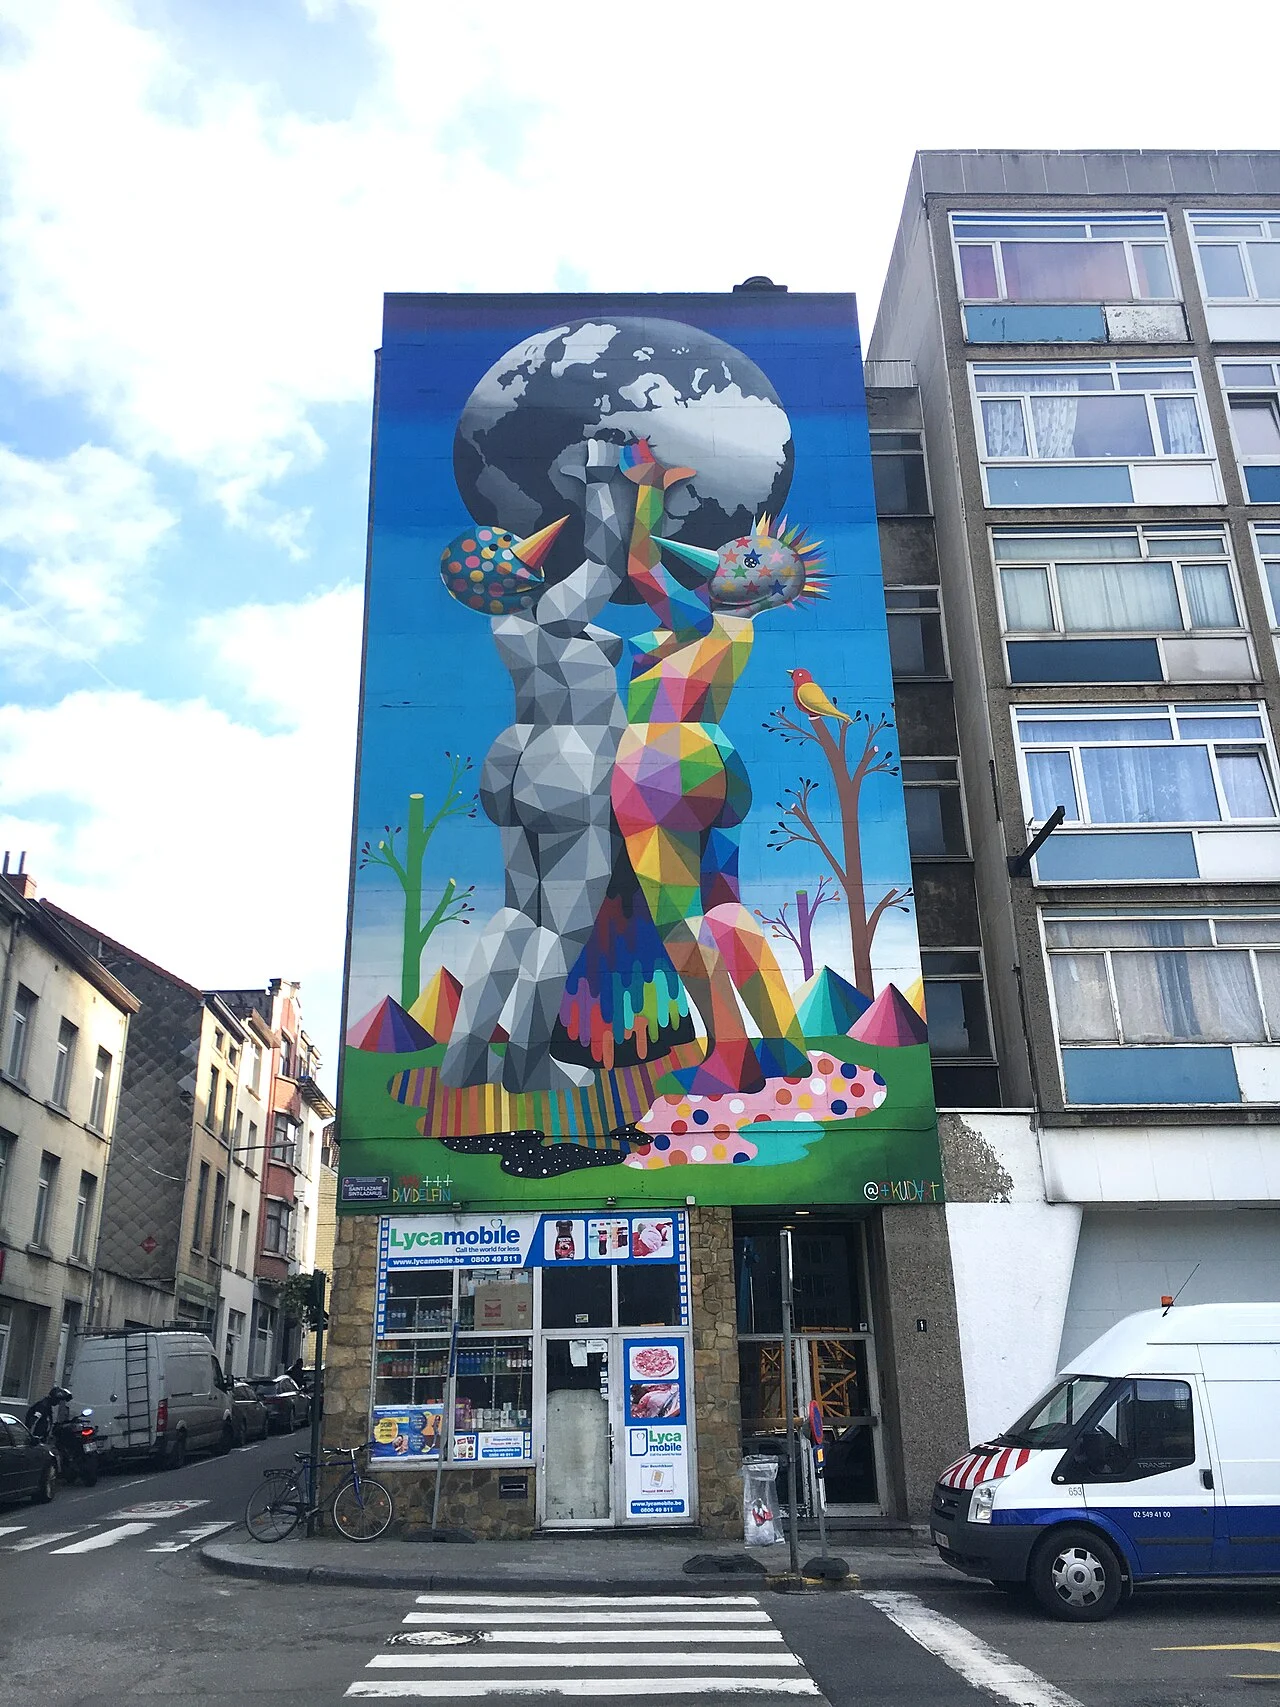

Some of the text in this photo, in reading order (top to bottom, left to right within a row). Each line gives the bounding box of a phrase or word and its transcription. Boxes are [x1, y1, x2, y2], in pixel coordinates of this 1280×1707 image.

[390, 1225, 520, 1250] Lycamobile
[393, 1257, 464, 1266] www.lycamobile.be
[649, 1430, 682, 1444] Lyca
[650, 1443, 682, 1451] mobile
[1068, 1487, 1082, 1496] 653
